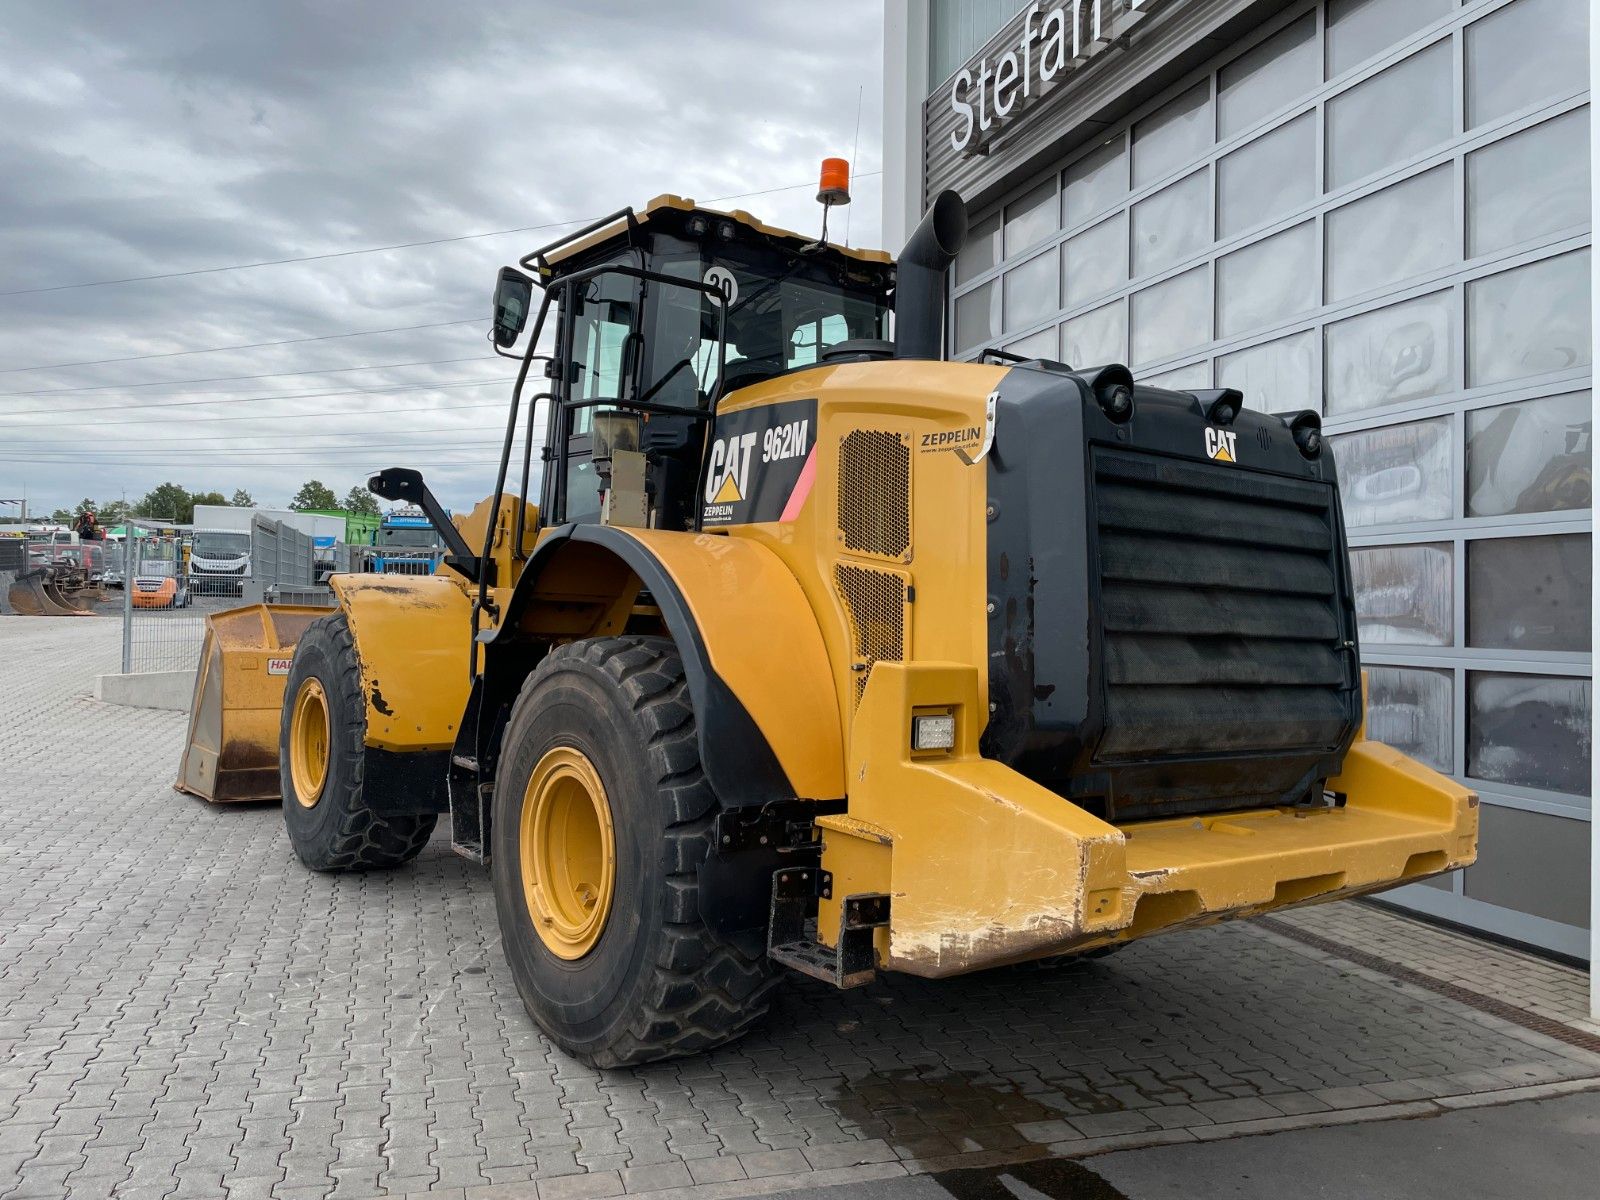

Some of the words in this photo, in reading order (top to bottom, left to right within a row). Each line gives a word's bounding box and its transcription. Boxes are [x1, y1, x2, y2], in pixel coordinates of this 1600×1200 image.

[951, 0, 1101, 151] Stefan
[762, 419, 809, 463] 962M
[921, 426, 981, 446] ZEPPELIN
[1204, 426, 1237, 463] CAT
[705, 431, 757, 504] CAT
[703, 504, 734, 517] ZEPPELIN
